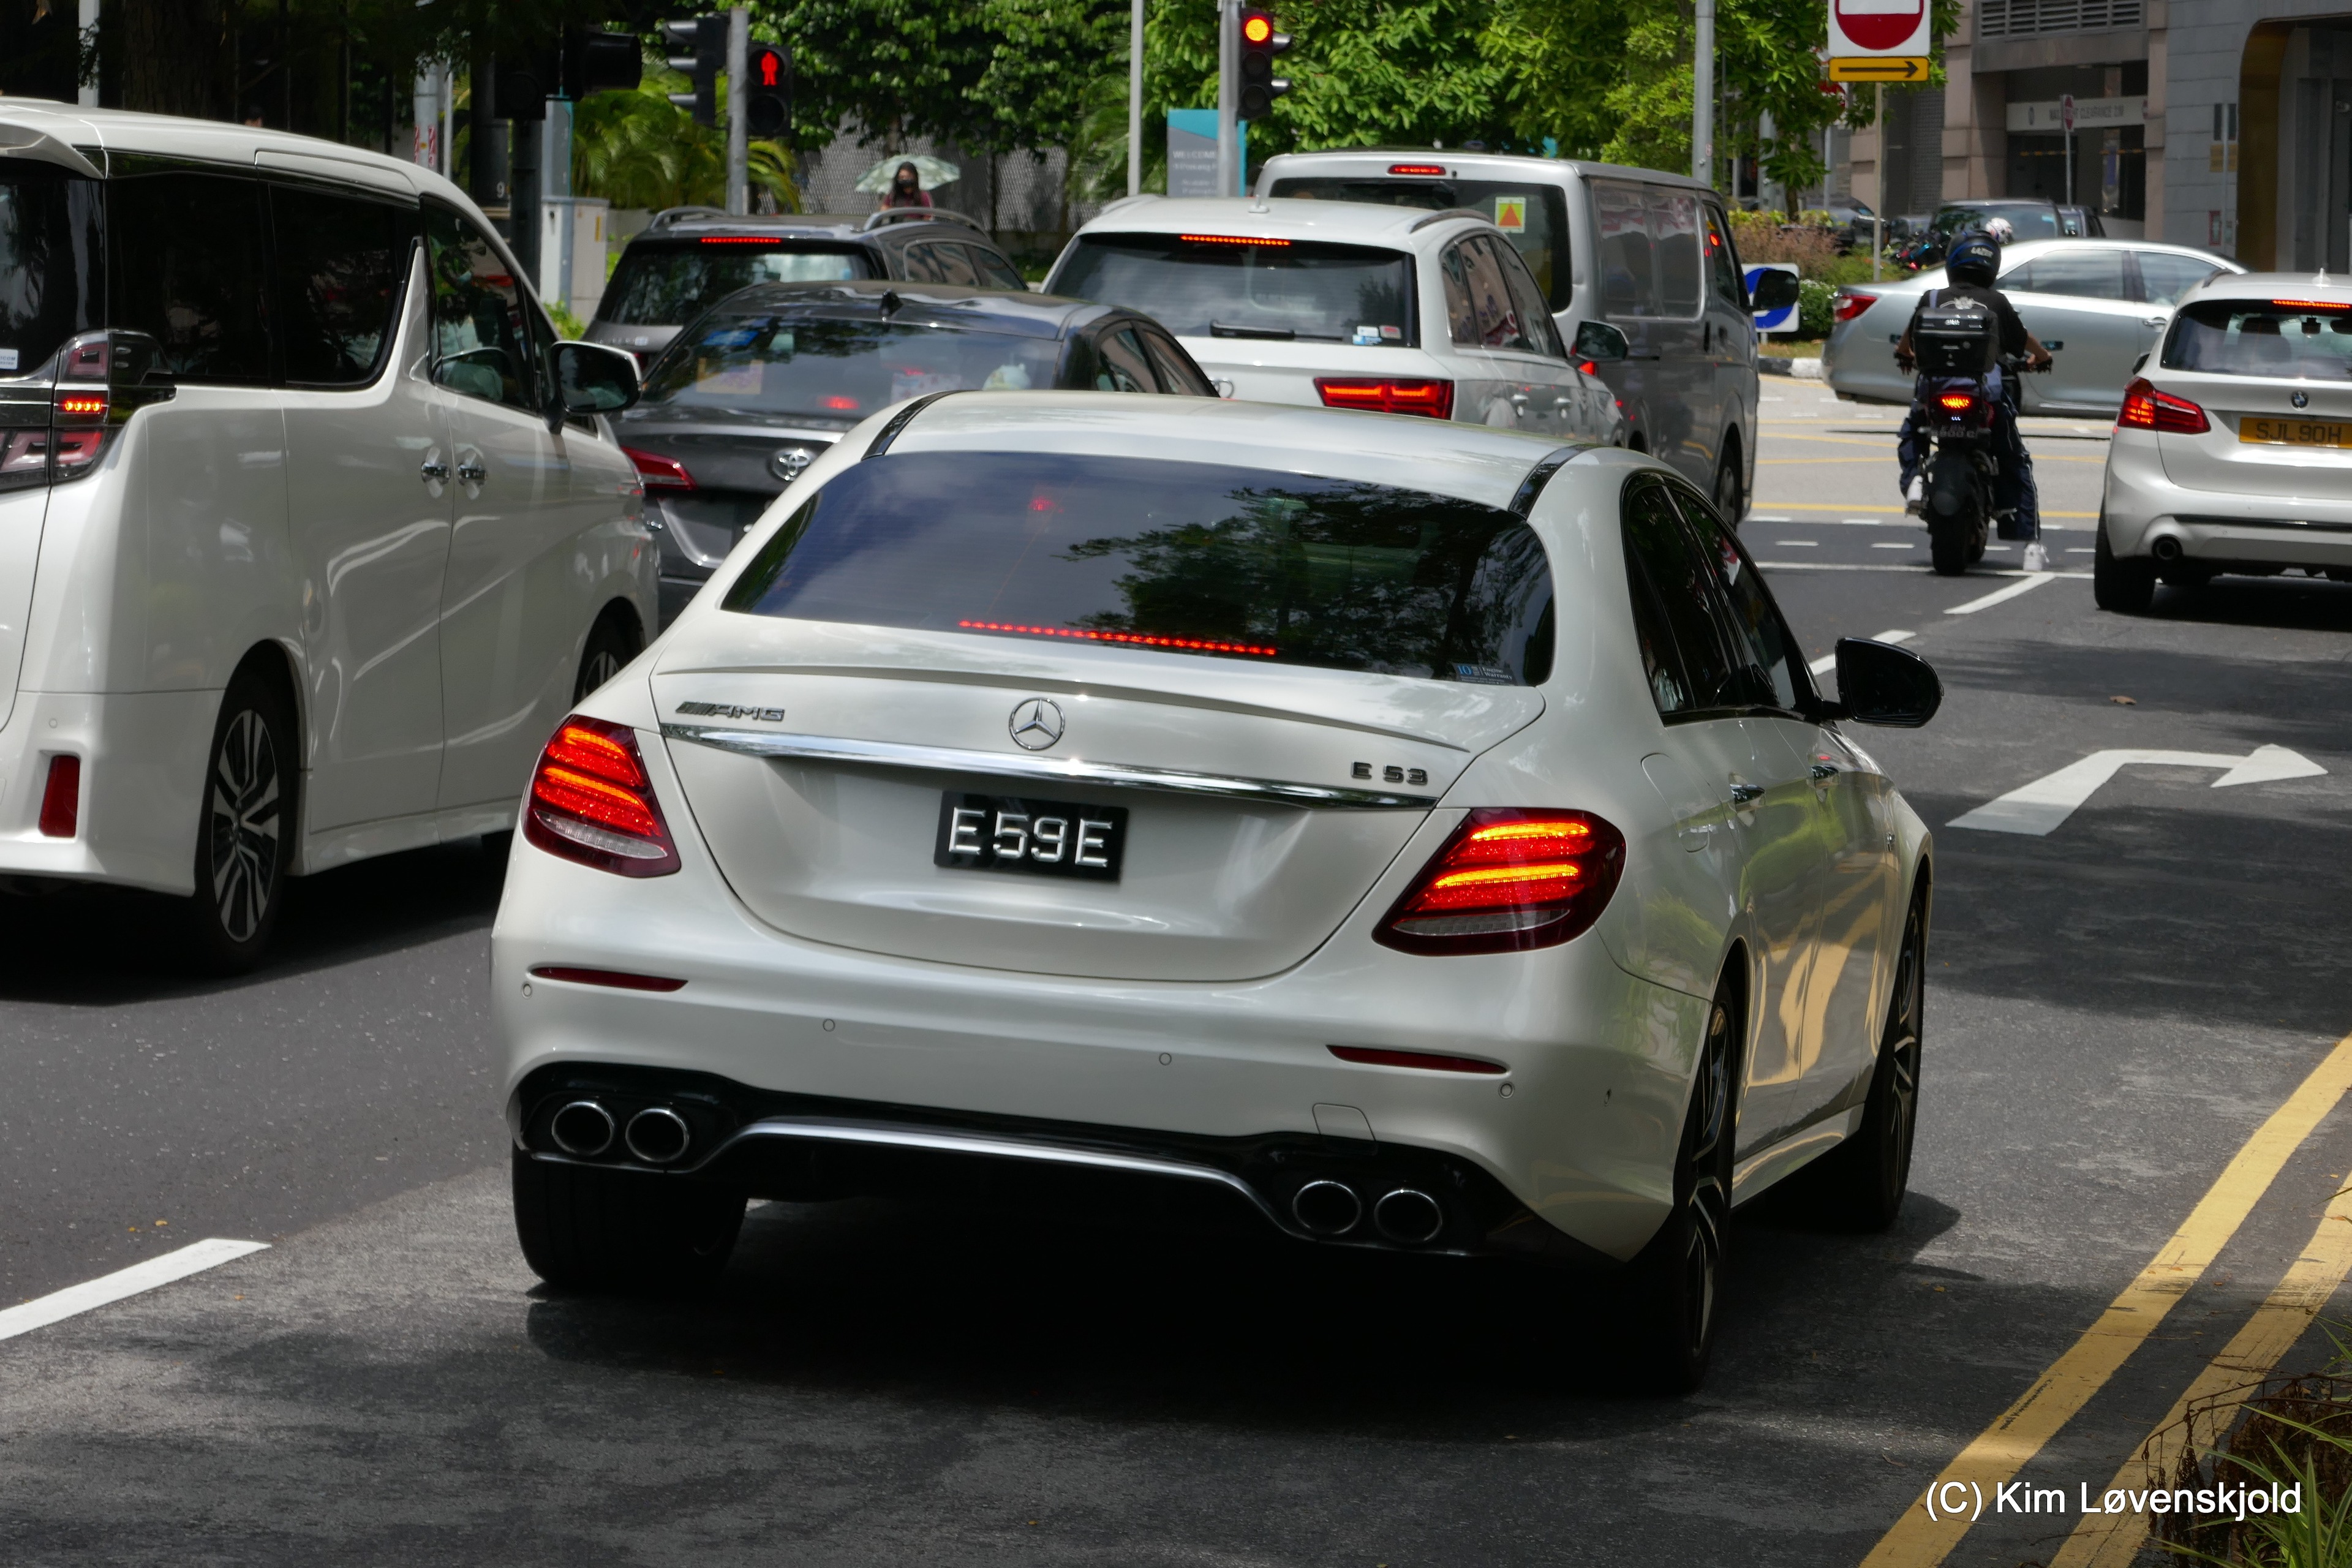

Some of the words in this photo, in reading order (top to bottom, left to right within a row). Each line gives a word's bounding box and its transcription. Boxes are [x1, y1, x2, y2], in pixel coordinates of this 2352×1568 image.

[496, 181, 505, 198] 9
[1484, 671, 1513, 680] Warranty
[706, 704, 785, 722] AMG
[1351, 761, 1372, 780] E
[1383, 765, 1428, 785] 53
